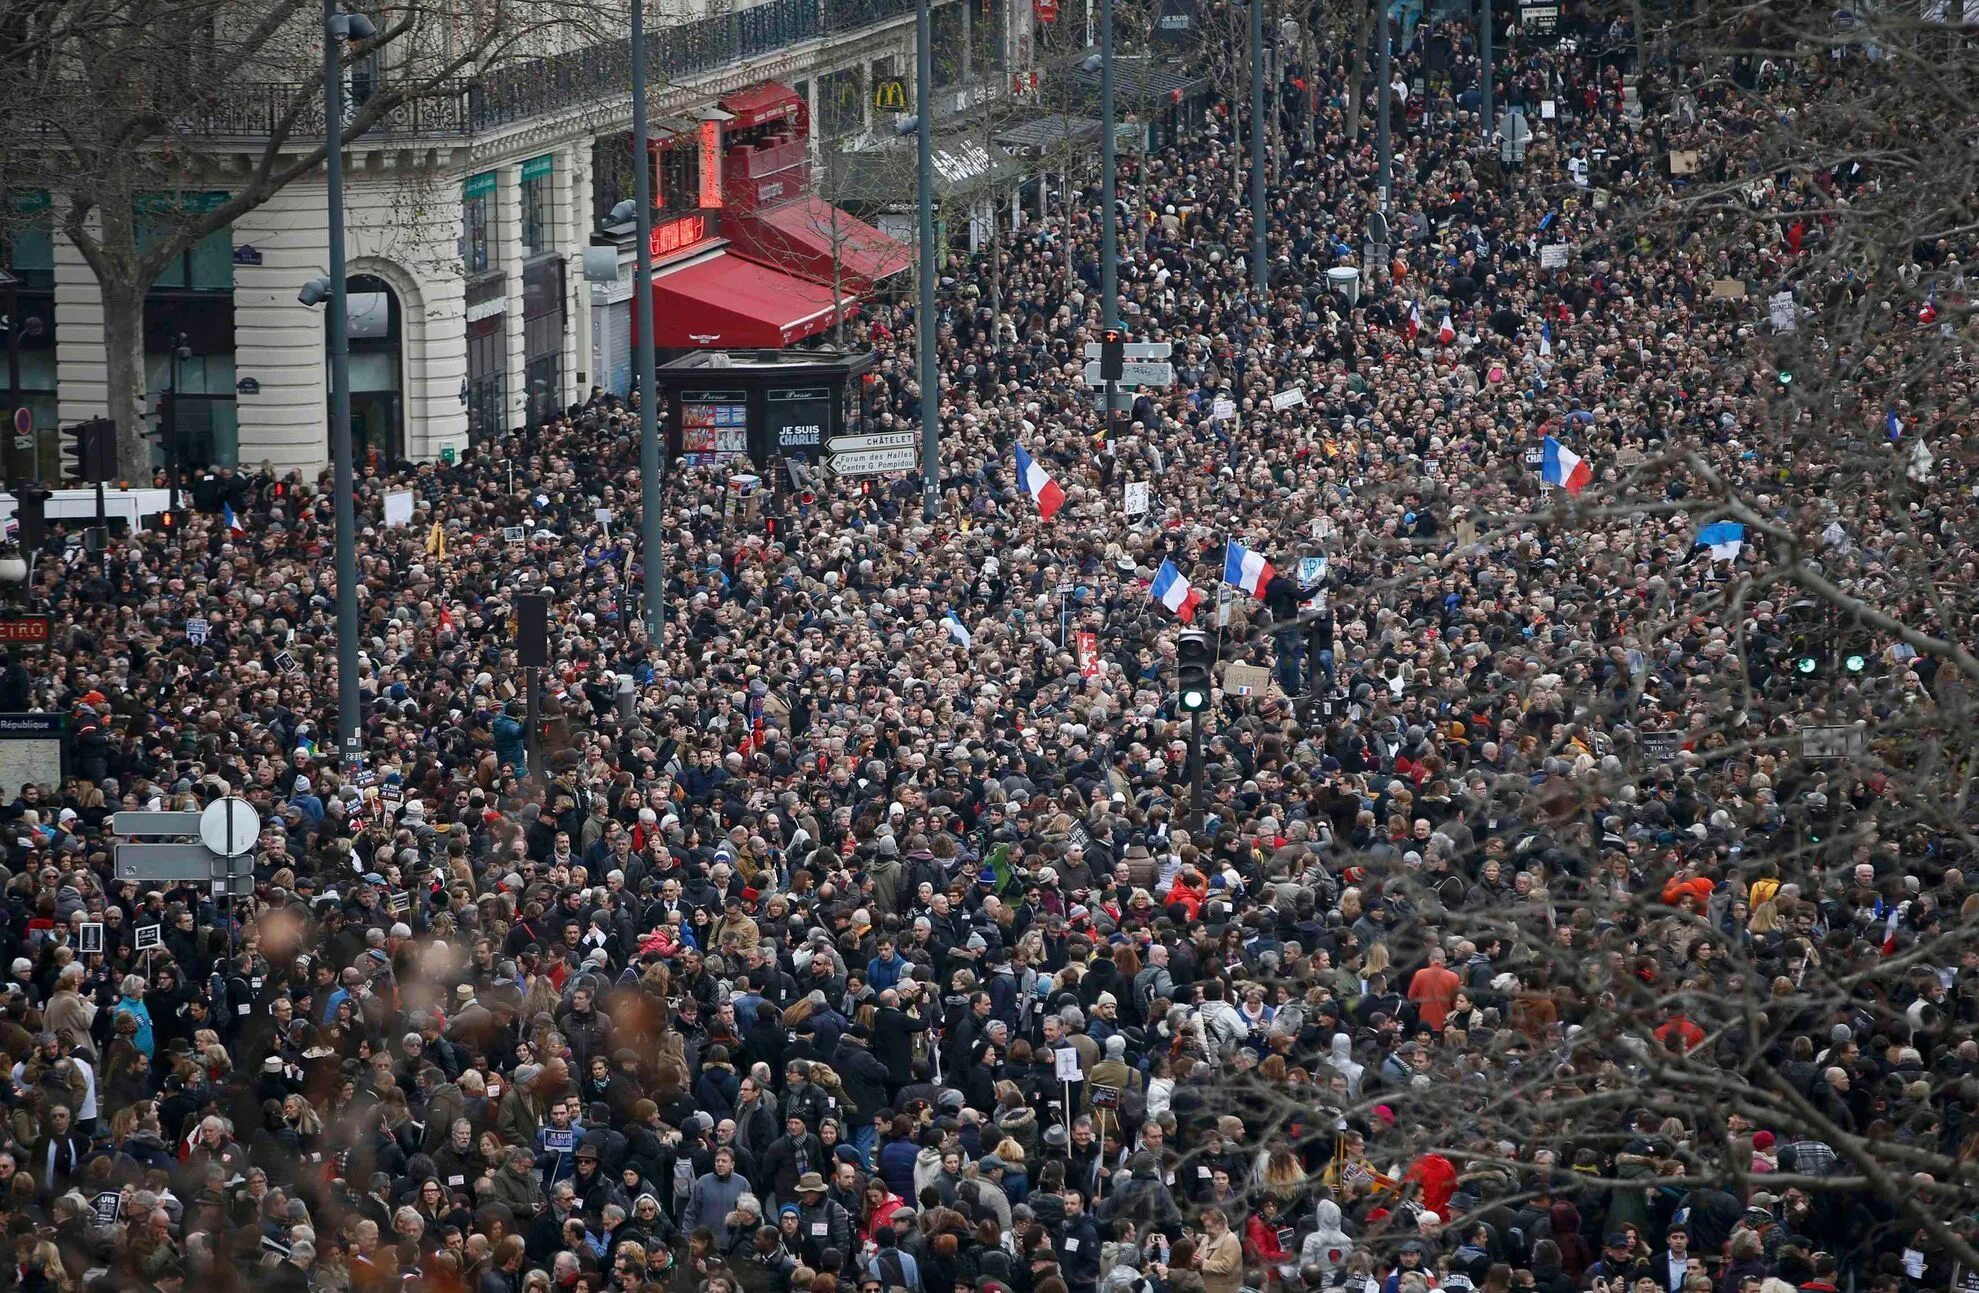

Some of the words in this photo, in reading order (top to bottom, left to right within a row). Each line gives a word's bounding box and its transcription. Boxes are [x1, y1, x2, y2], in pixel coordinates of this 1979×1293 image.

[1003, 146, 1030, 156] KFC
[786, 390, 812, 398] Presse
[779, 426, 793, 434] JE
[795, 425, 820, 434] SUIS
[779, 434, 820, 445] CHARLIE
[867, 434, 912, 446] CHÂTELET
[841, 455, 866, 463] Forum
[887, 450, 913, 459] Halles
[842, 463, 866, 472] Centre
[878, 460, 913, 469] Pompidou
[0, 720, 49, 730] République
